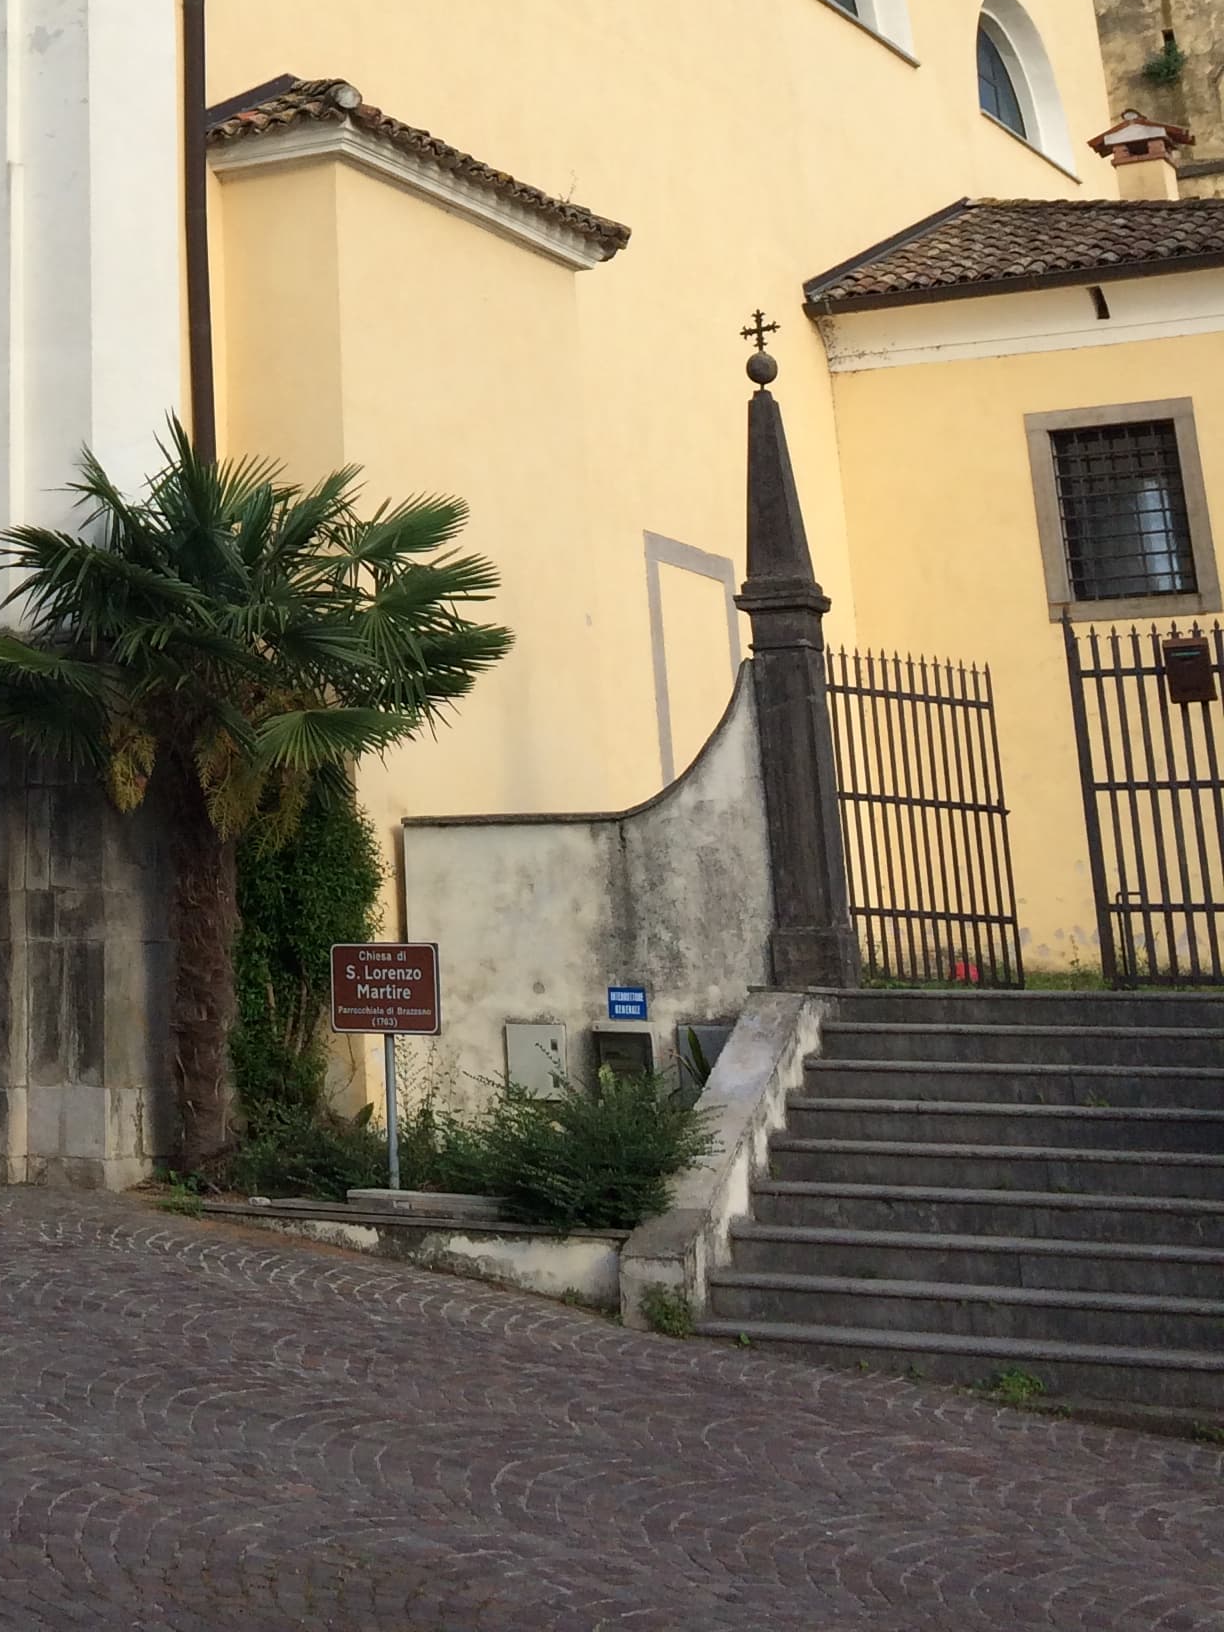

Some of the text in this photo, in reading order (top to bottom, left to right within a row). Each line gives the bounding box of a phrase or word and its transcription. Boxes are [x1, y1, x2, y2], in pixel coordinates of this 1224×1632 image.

[358, 950, 407, 961] Chiesa di
[346, 964, 422, 980] S. Lorenzo
[357, 984, 412, 999] Martire
[386, 1006, 394, 1015] di
